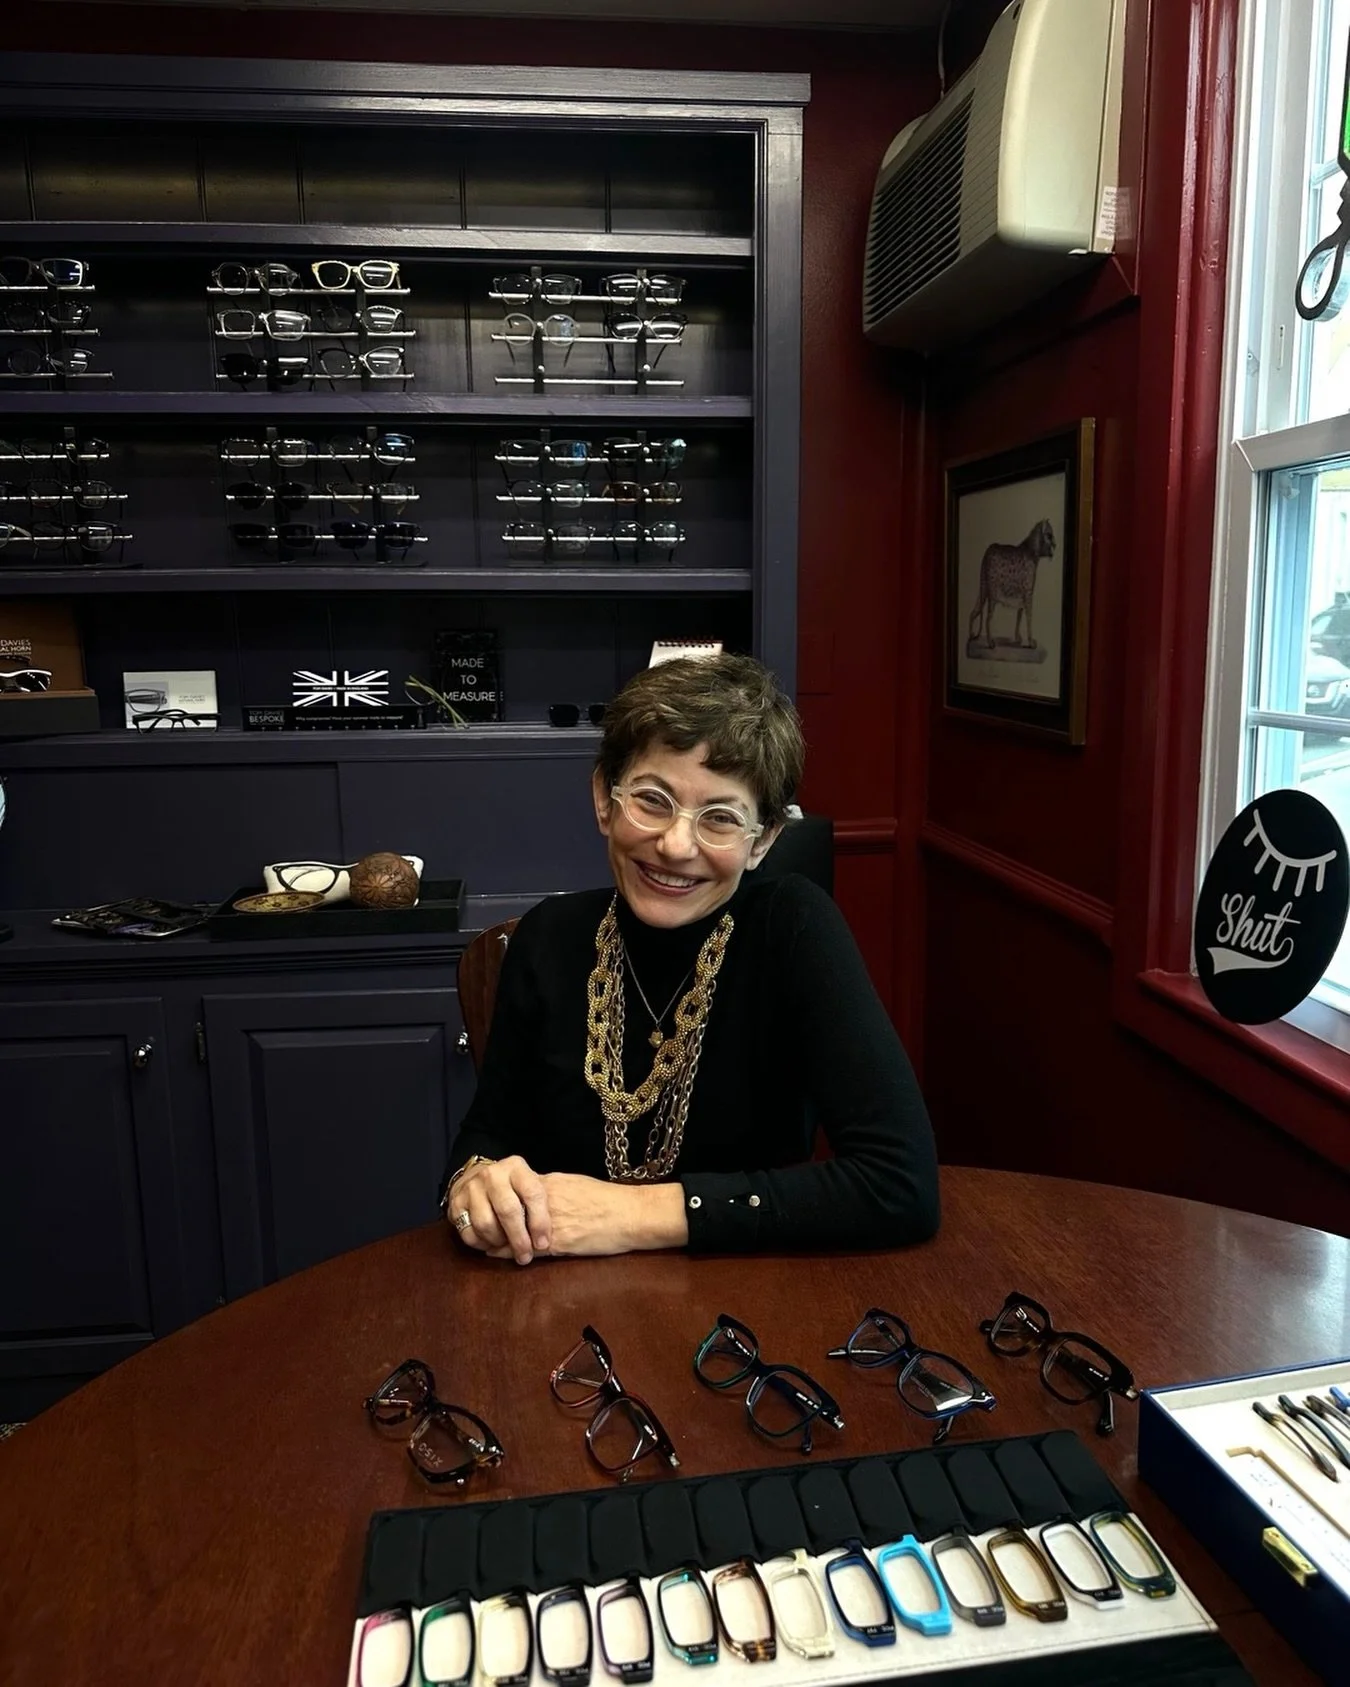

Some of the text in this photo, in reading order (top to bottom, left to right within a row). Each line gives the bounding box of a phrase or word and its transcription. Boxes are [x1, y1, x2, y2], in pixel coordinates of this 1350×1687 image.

[451, 657, 485, 669] MADE
[460, 674, 477, 685] TO
[443, 691, 496, 702] MEASURE
[249, 715, 285, 723] BESPOKE
[1216, 892, 1302, 956] Shut
